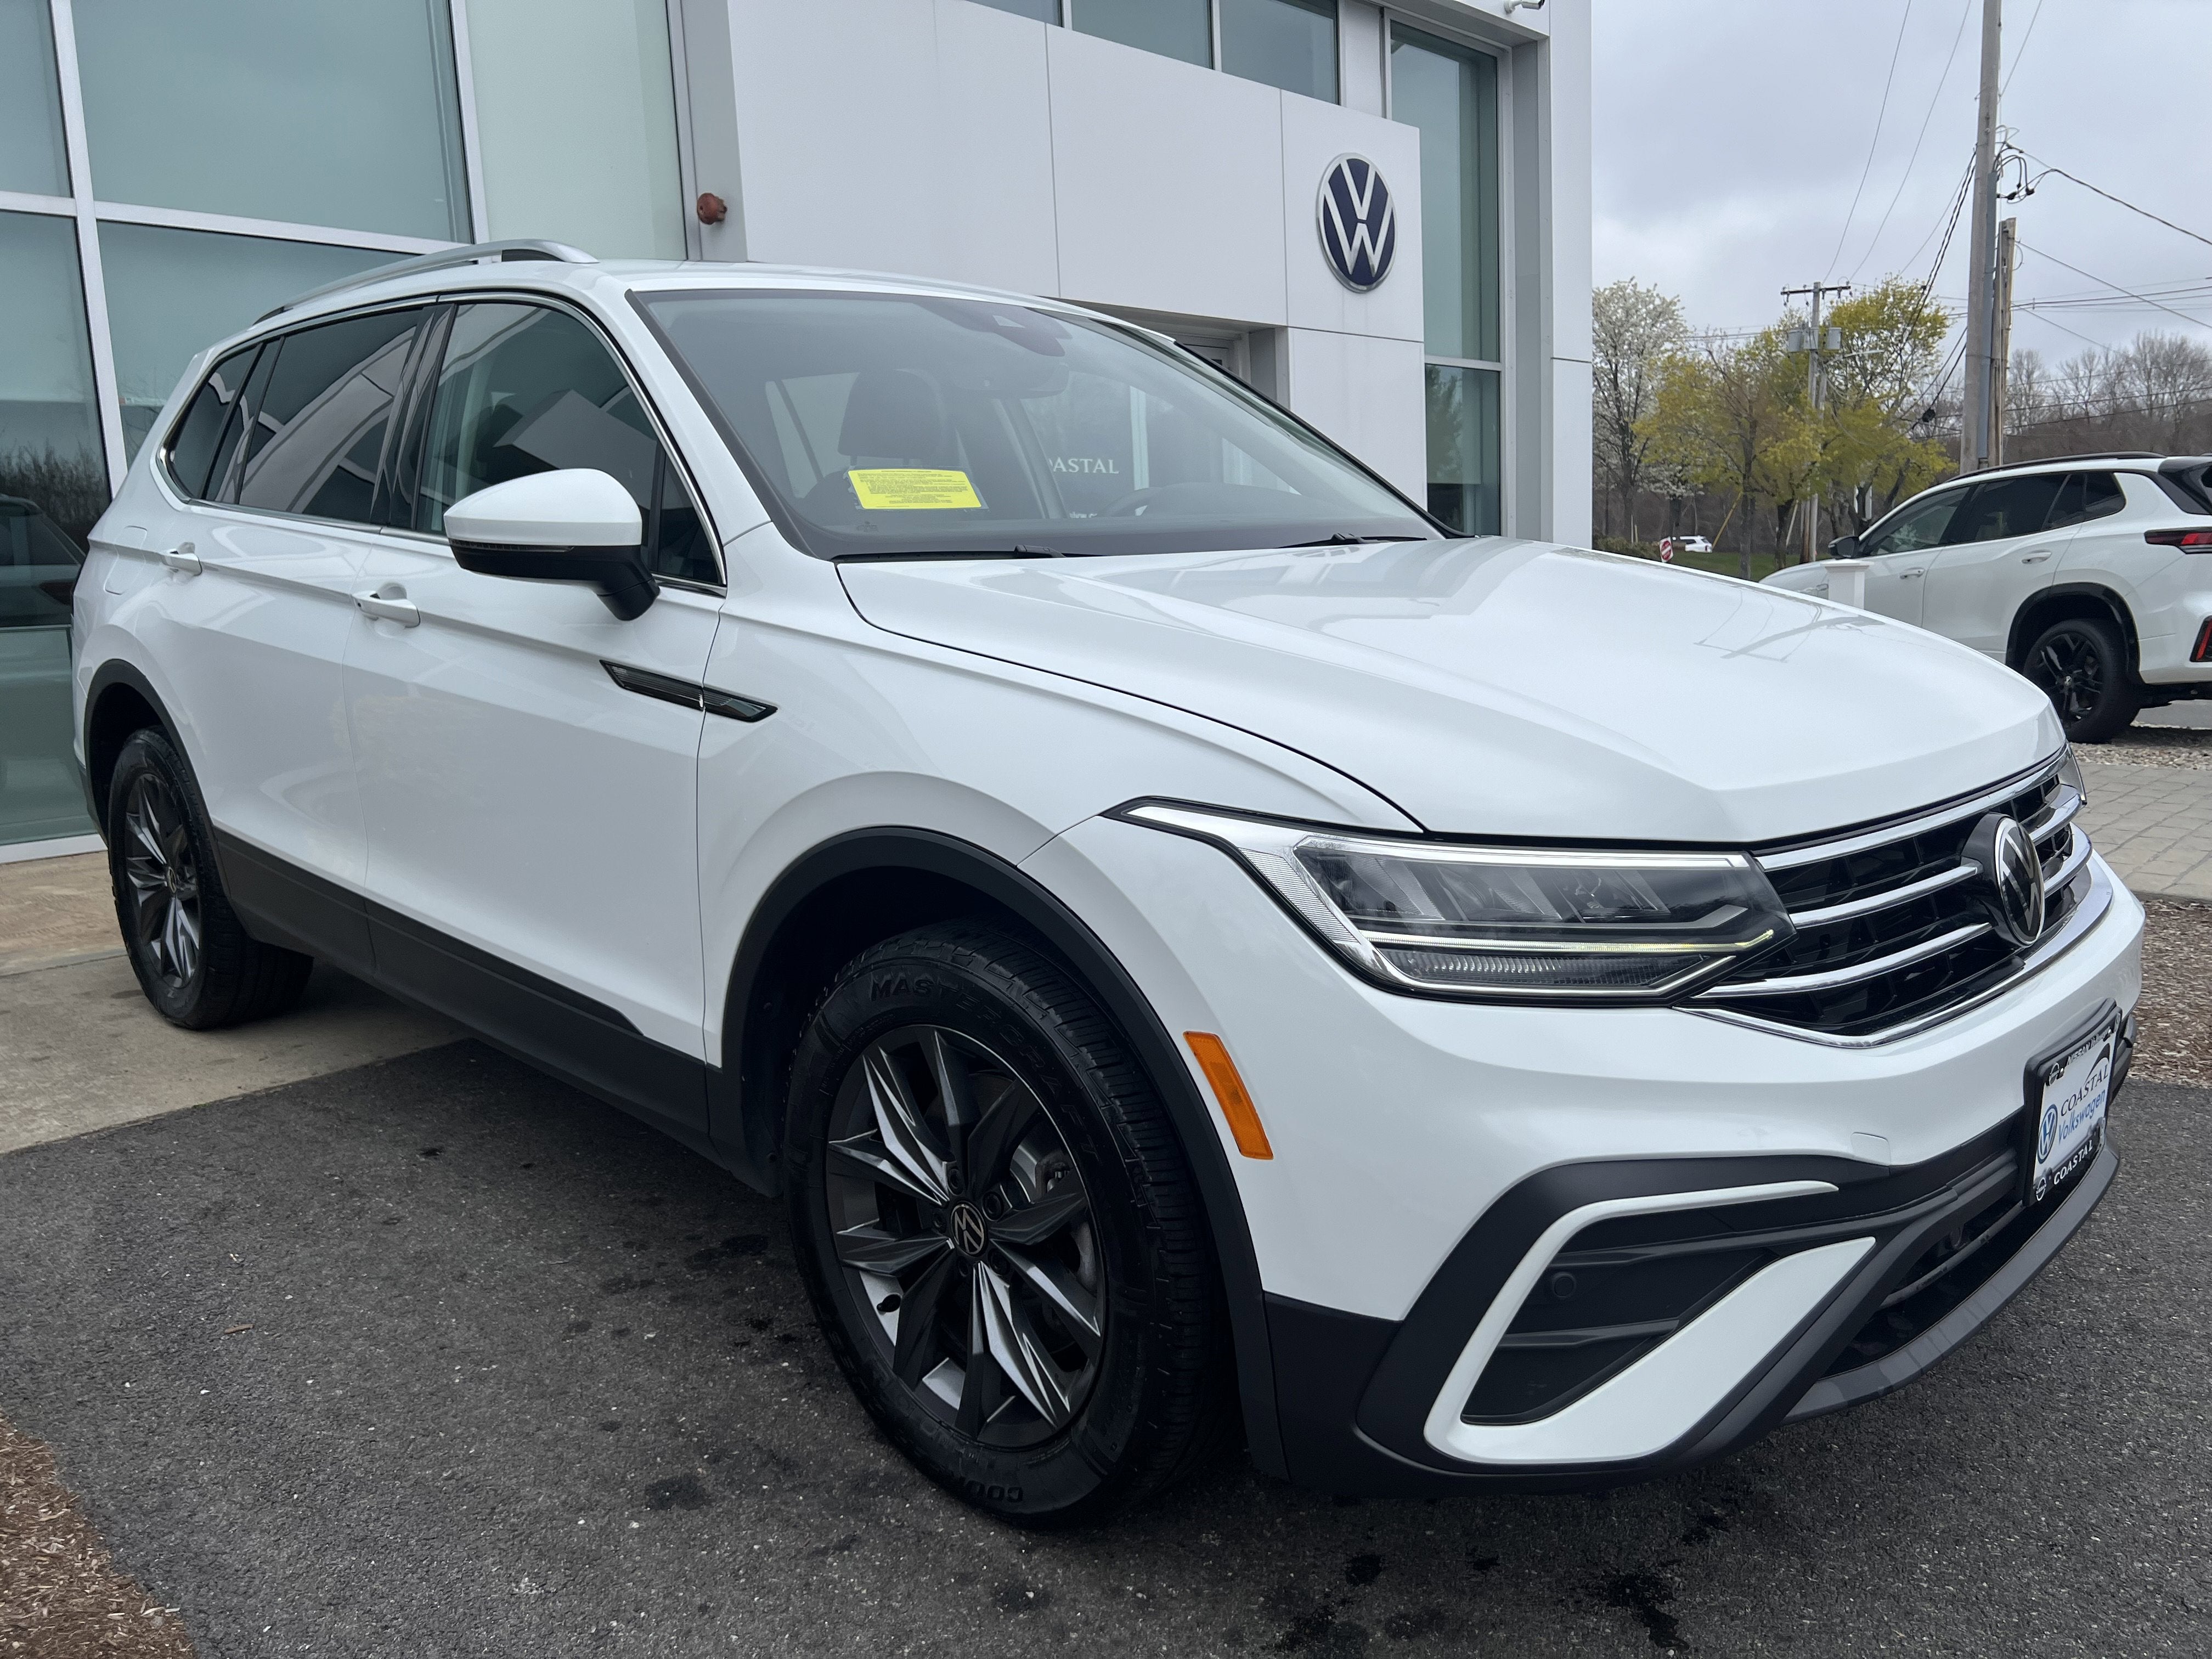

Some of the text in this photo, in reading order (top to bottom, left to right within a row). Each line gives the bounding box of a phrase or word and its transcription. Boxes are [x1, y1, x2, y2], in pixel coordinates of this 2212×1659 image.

[1317, 153, 1397, 292] VW
[1048, 458, 1119, 474] ASTAL
[2058, 1089, 2106, 1144] Volkswagen
[2061, 1064, 2108, 1116] COASTAL
[2037, 1104, 2058, 1164] VW
[2053, 1139, 2093, 1185] COASTAL
